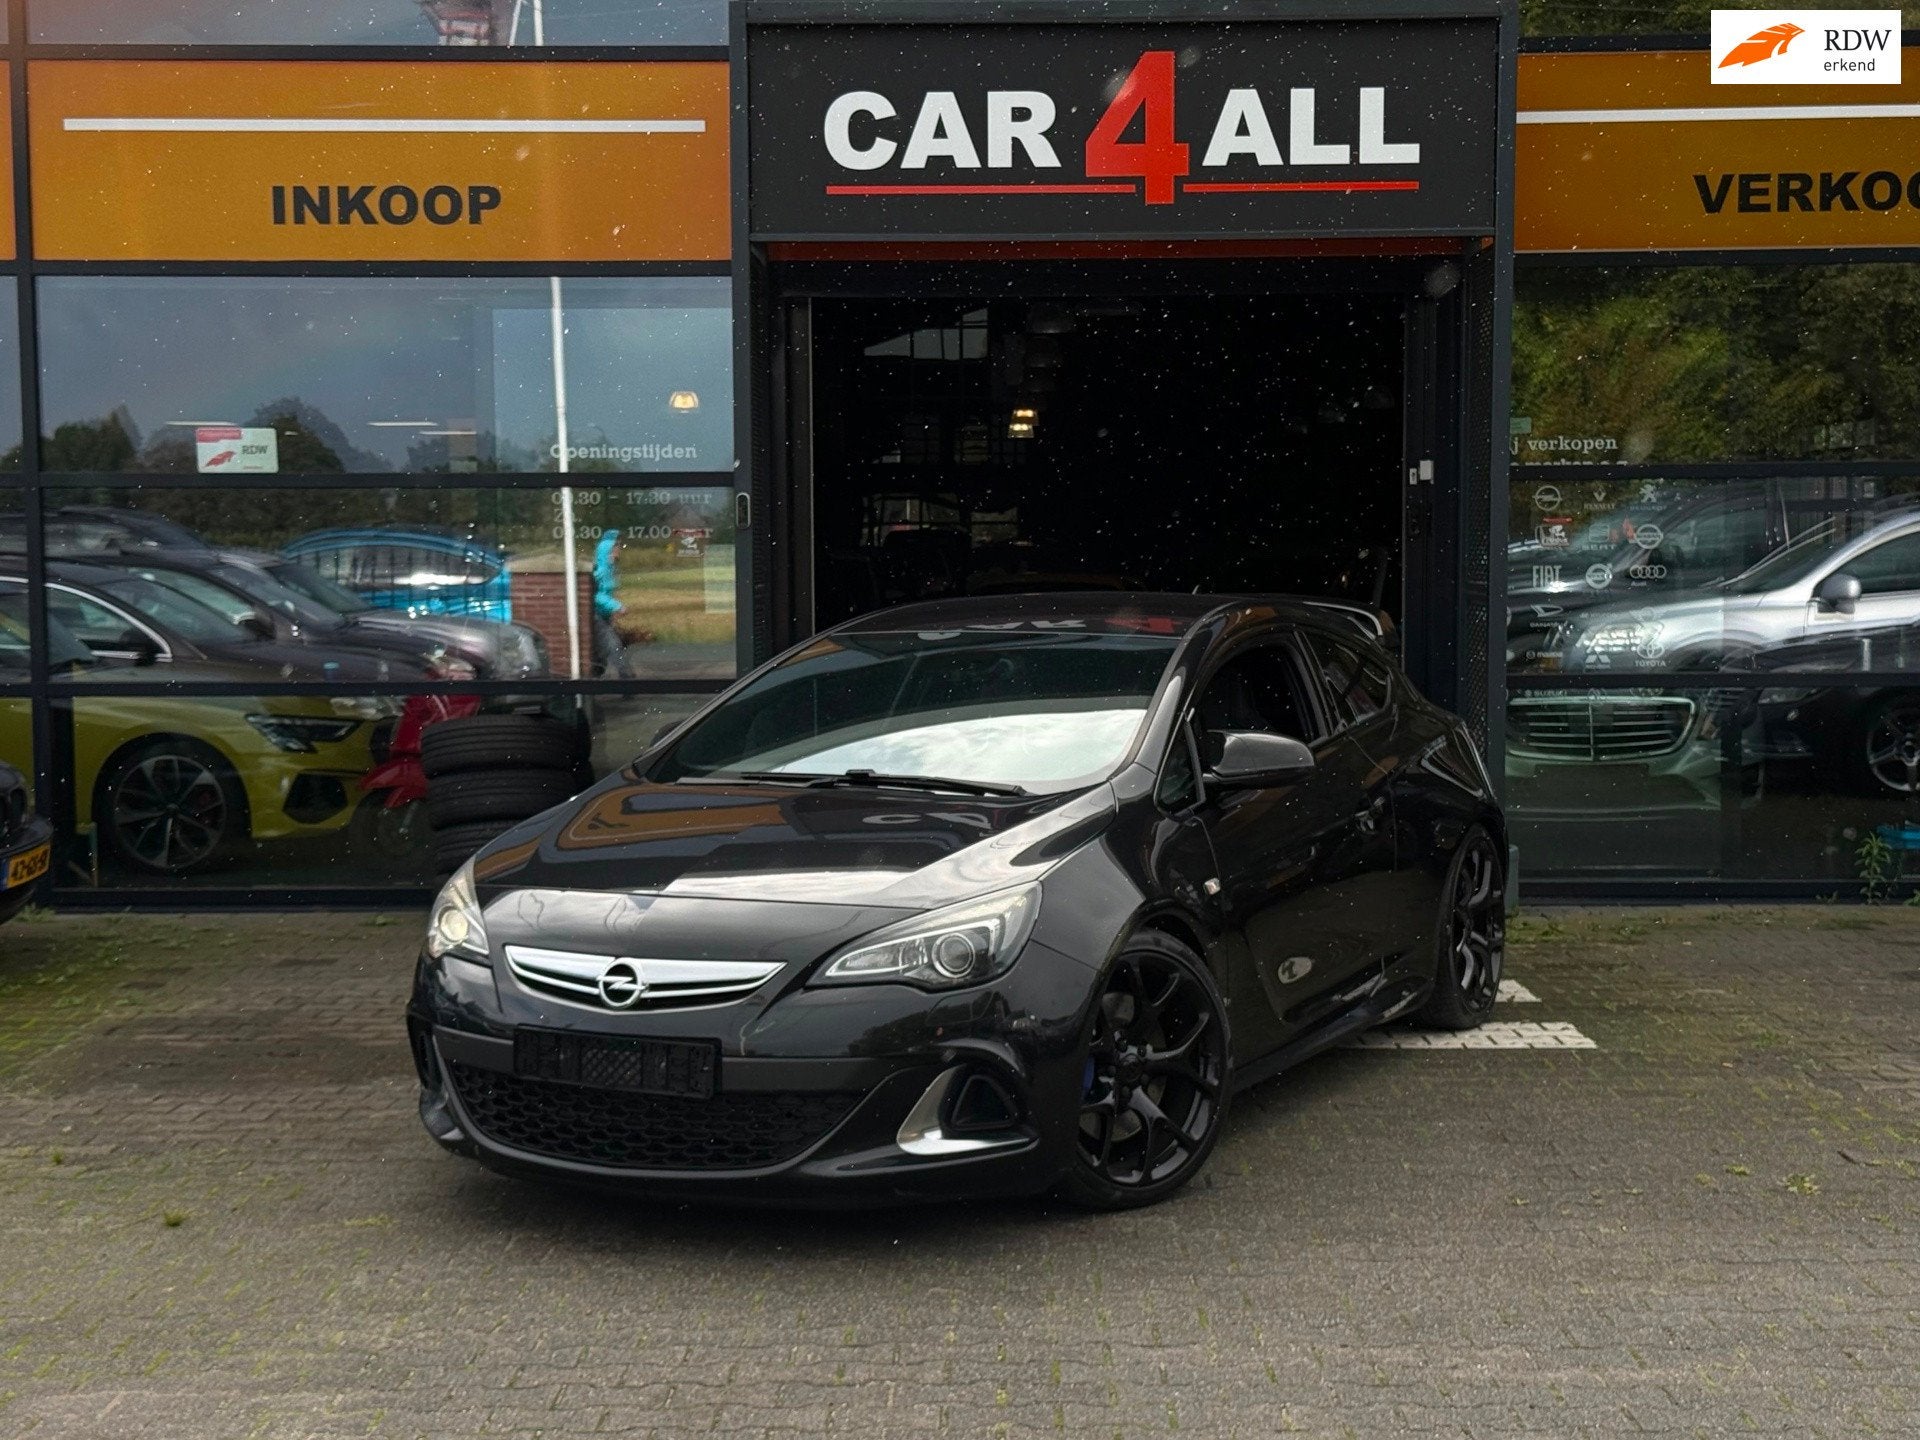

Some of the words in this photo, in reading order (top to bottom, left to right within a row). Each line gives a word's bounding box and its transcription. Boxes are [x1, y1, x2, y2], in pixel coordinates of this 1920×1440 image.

[272, 184, 503, 226] INKOOP
[242, 445, 268, 455] RDW
[549, 444, 698, 462] Openingstijden
[1527, 435, 1619, 454] verkopen
[626, 525, 672, 539] 17.00
